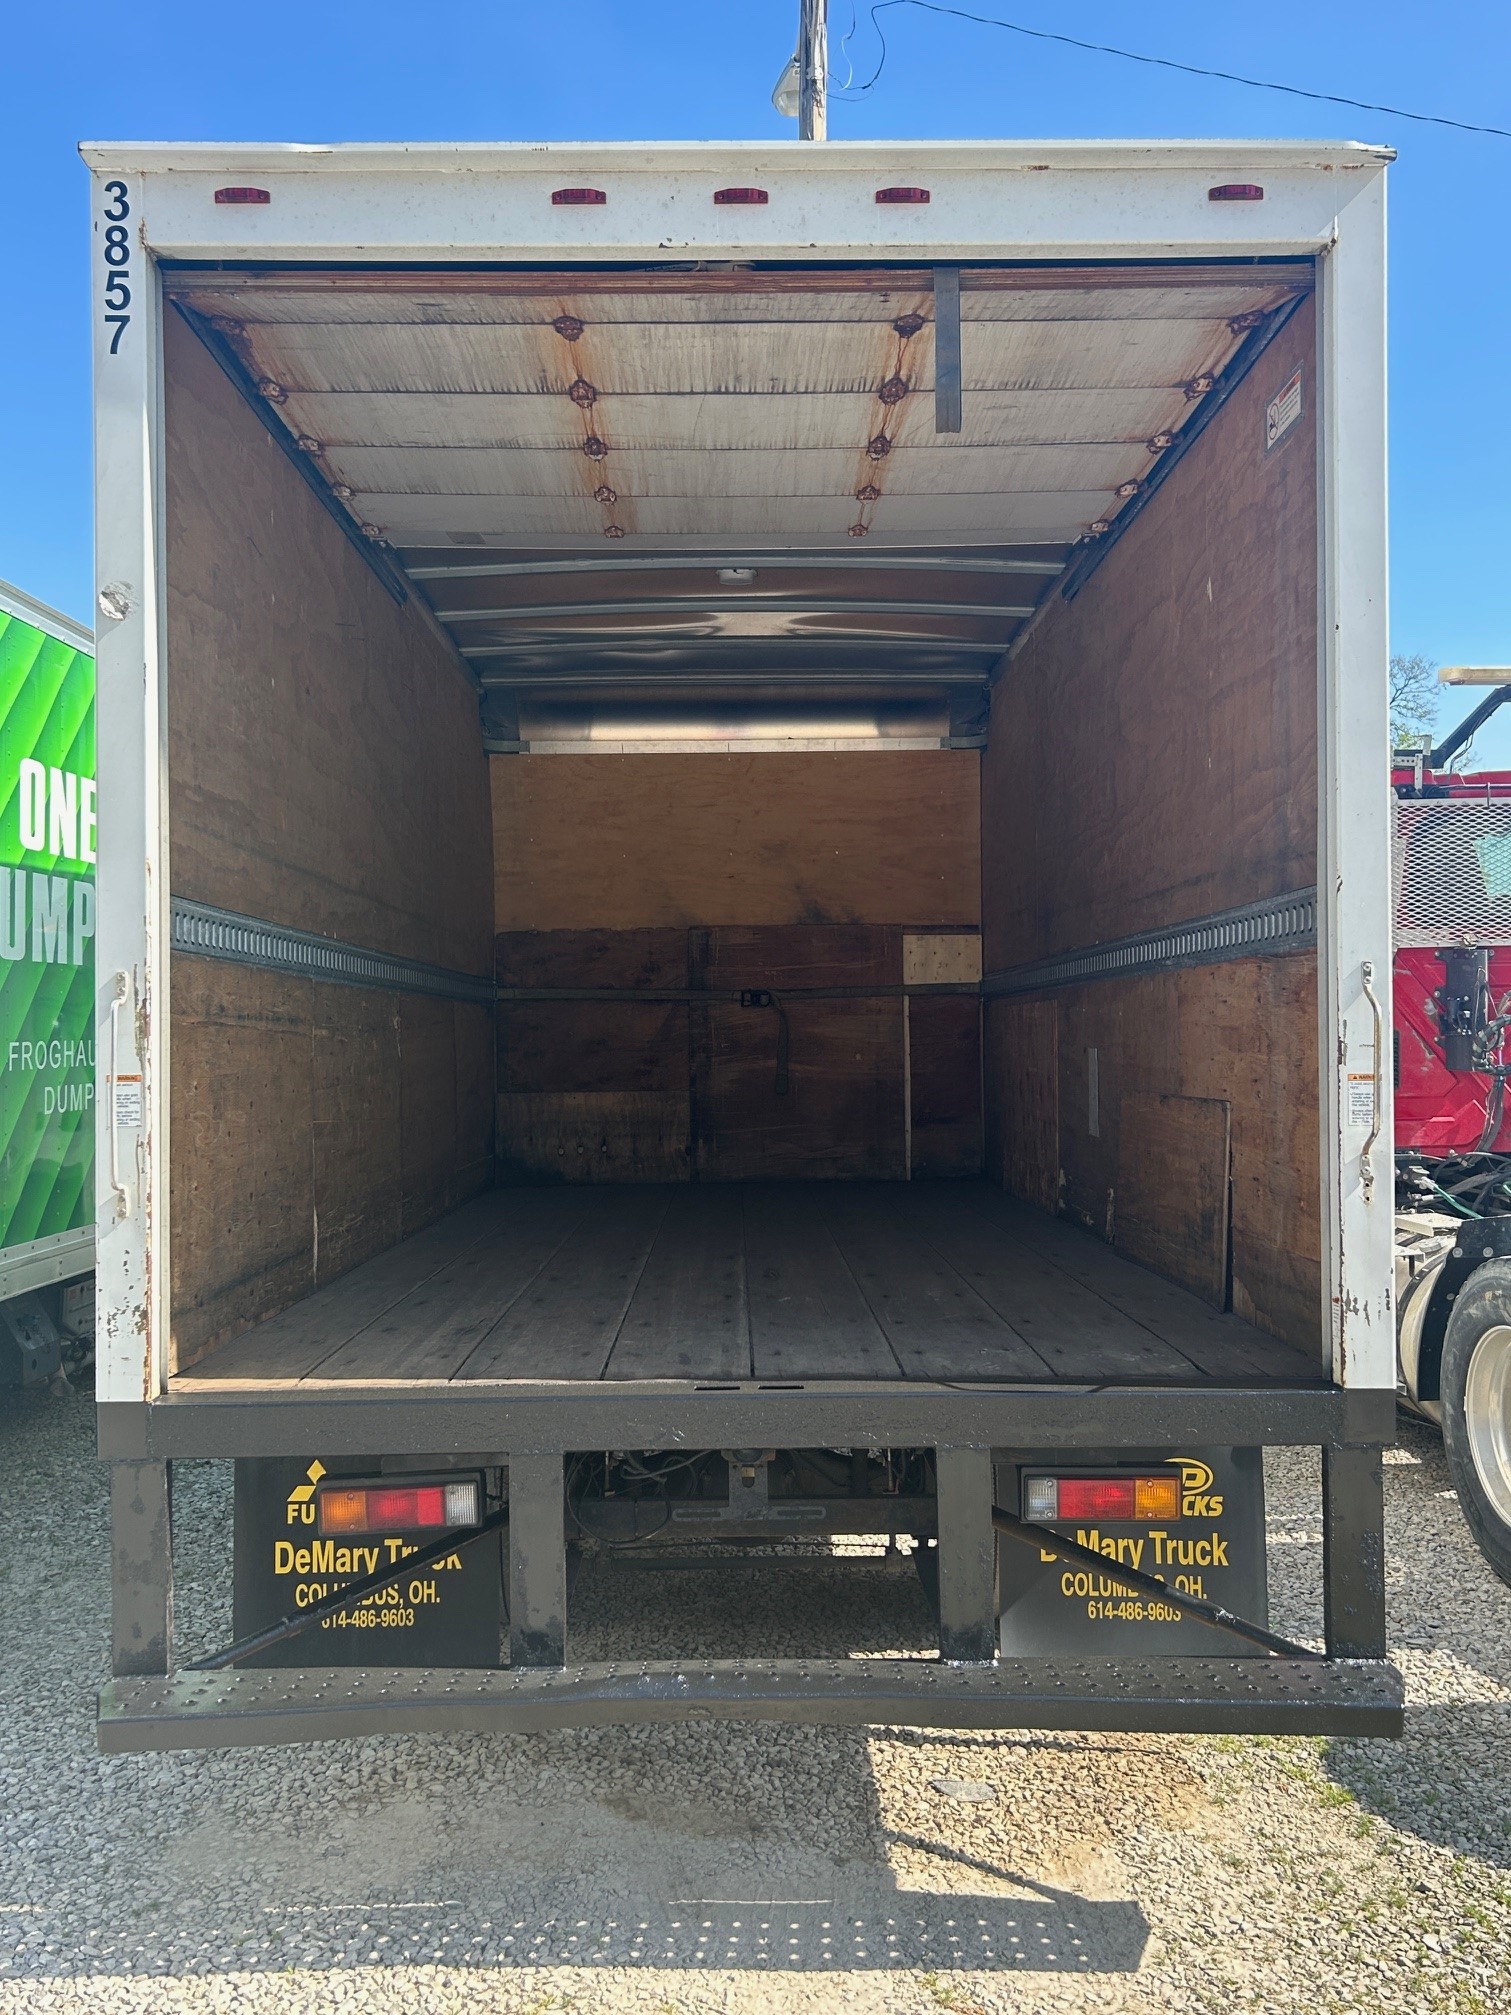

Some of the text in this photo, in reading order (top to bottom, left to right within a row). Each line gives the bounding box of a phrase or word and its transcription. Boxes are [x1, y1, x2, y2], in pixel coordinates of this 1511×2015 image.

[104, 180, 132, 355] 3857
[19, 757, 96, 864] ONE
[44, 1083, 94, 1115] DUMP
[274, 1540, 379, 1575] DeMary
[1040, 1529, 1229, 1570] Mary Truck
[409, 1580, 440, 1604] OH.
